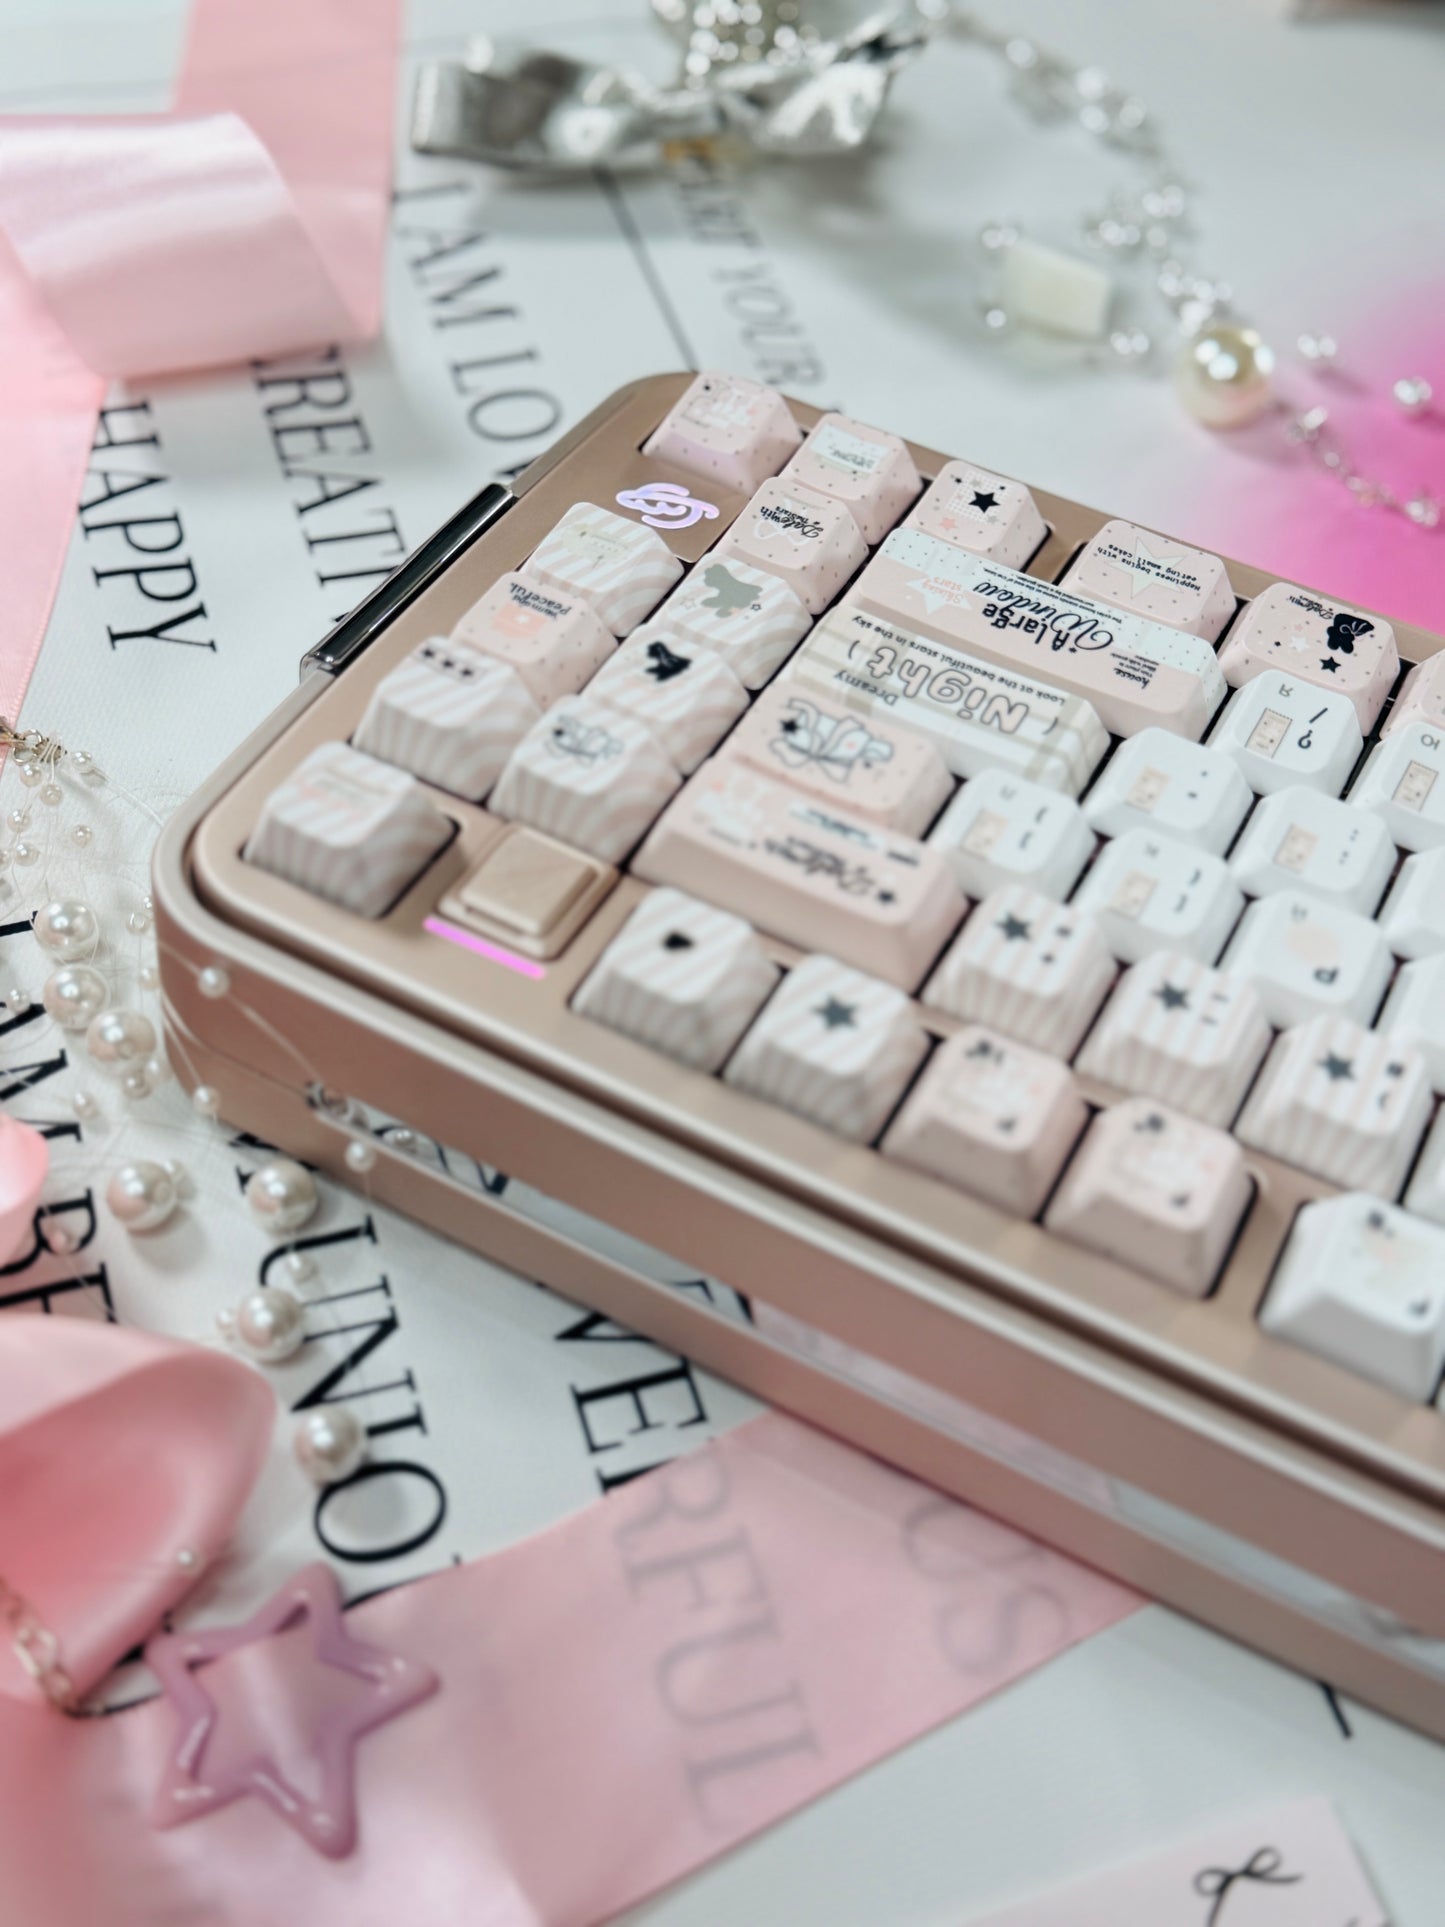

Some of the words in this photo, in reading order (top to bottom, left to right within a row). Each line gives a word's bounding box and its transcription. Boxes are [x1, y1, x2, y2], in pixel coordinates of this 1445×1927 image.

[396, 225, 522, 332] AM
[252, 345, 406, 622] REATI
[78, 399, 217, 652] HAPPY
[1097, 546, 1117, 559] with
[1108, 544, 1133, 557] cakes
[1121, 557, 1152, 575] begins
[1137, 556, 1162, 569] small
[1155, 571, 1201, 591] Happiness
[1165, 567, 1197, 582] eating
[852, 615, 873, 629] sky
[972, 581, 1114, 651] Window
[981, 603, 1048, 645] large
[873, 626, 894, 640] the
[895, 635, 907, 647] in
[909, 641, 939, 658] stars
[940, 654, 996, 681] beautiful
[998, 675, 1018, 689] the
[1113, 667, 1150, 690] house
[833, 669, 899, 707] Dreamy
[866, 646, 1030, 735] Night
[1020, 684, 1034, 693] at
[1036, 690, 1066, 707] Look
